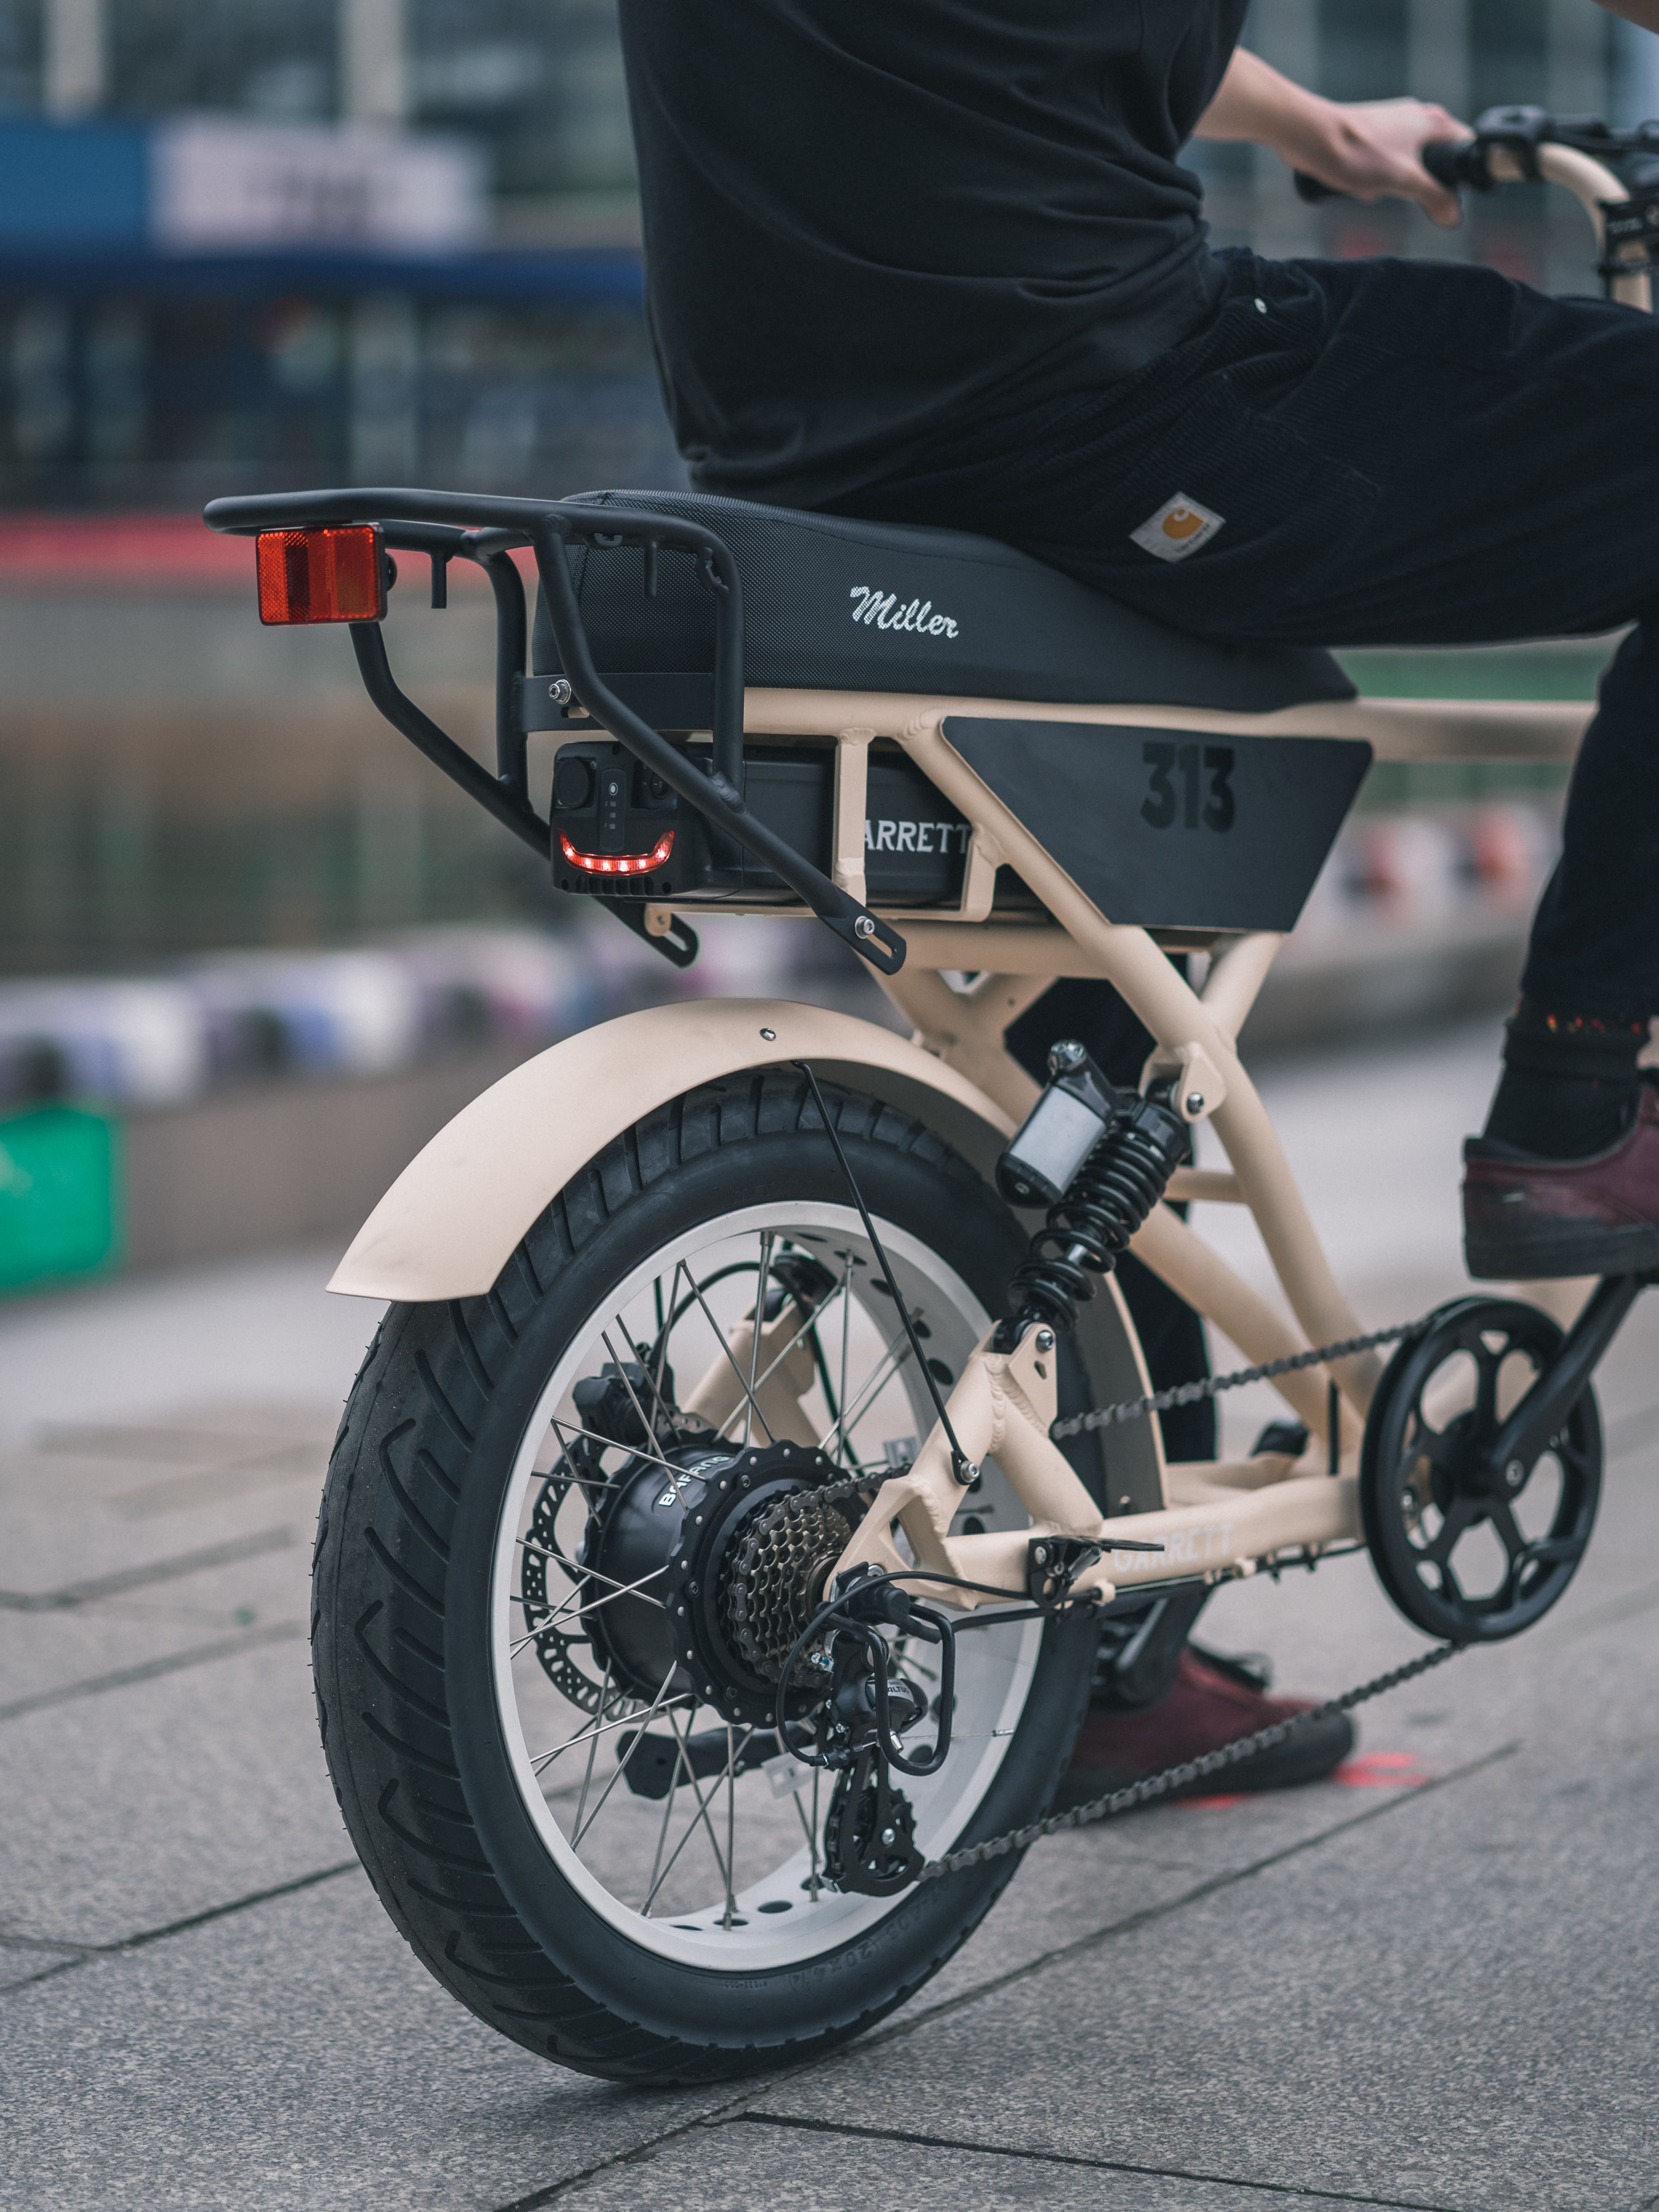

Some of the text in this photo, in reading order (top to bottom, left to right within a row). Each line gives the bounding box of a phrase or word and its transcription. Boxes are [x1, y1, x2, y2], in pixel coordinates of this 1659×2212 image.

[850, 586, 959, 638] Miller
[1141, 741, 1235, 833] 313
[1113, 1523, 1235, 1572] GARRETT
